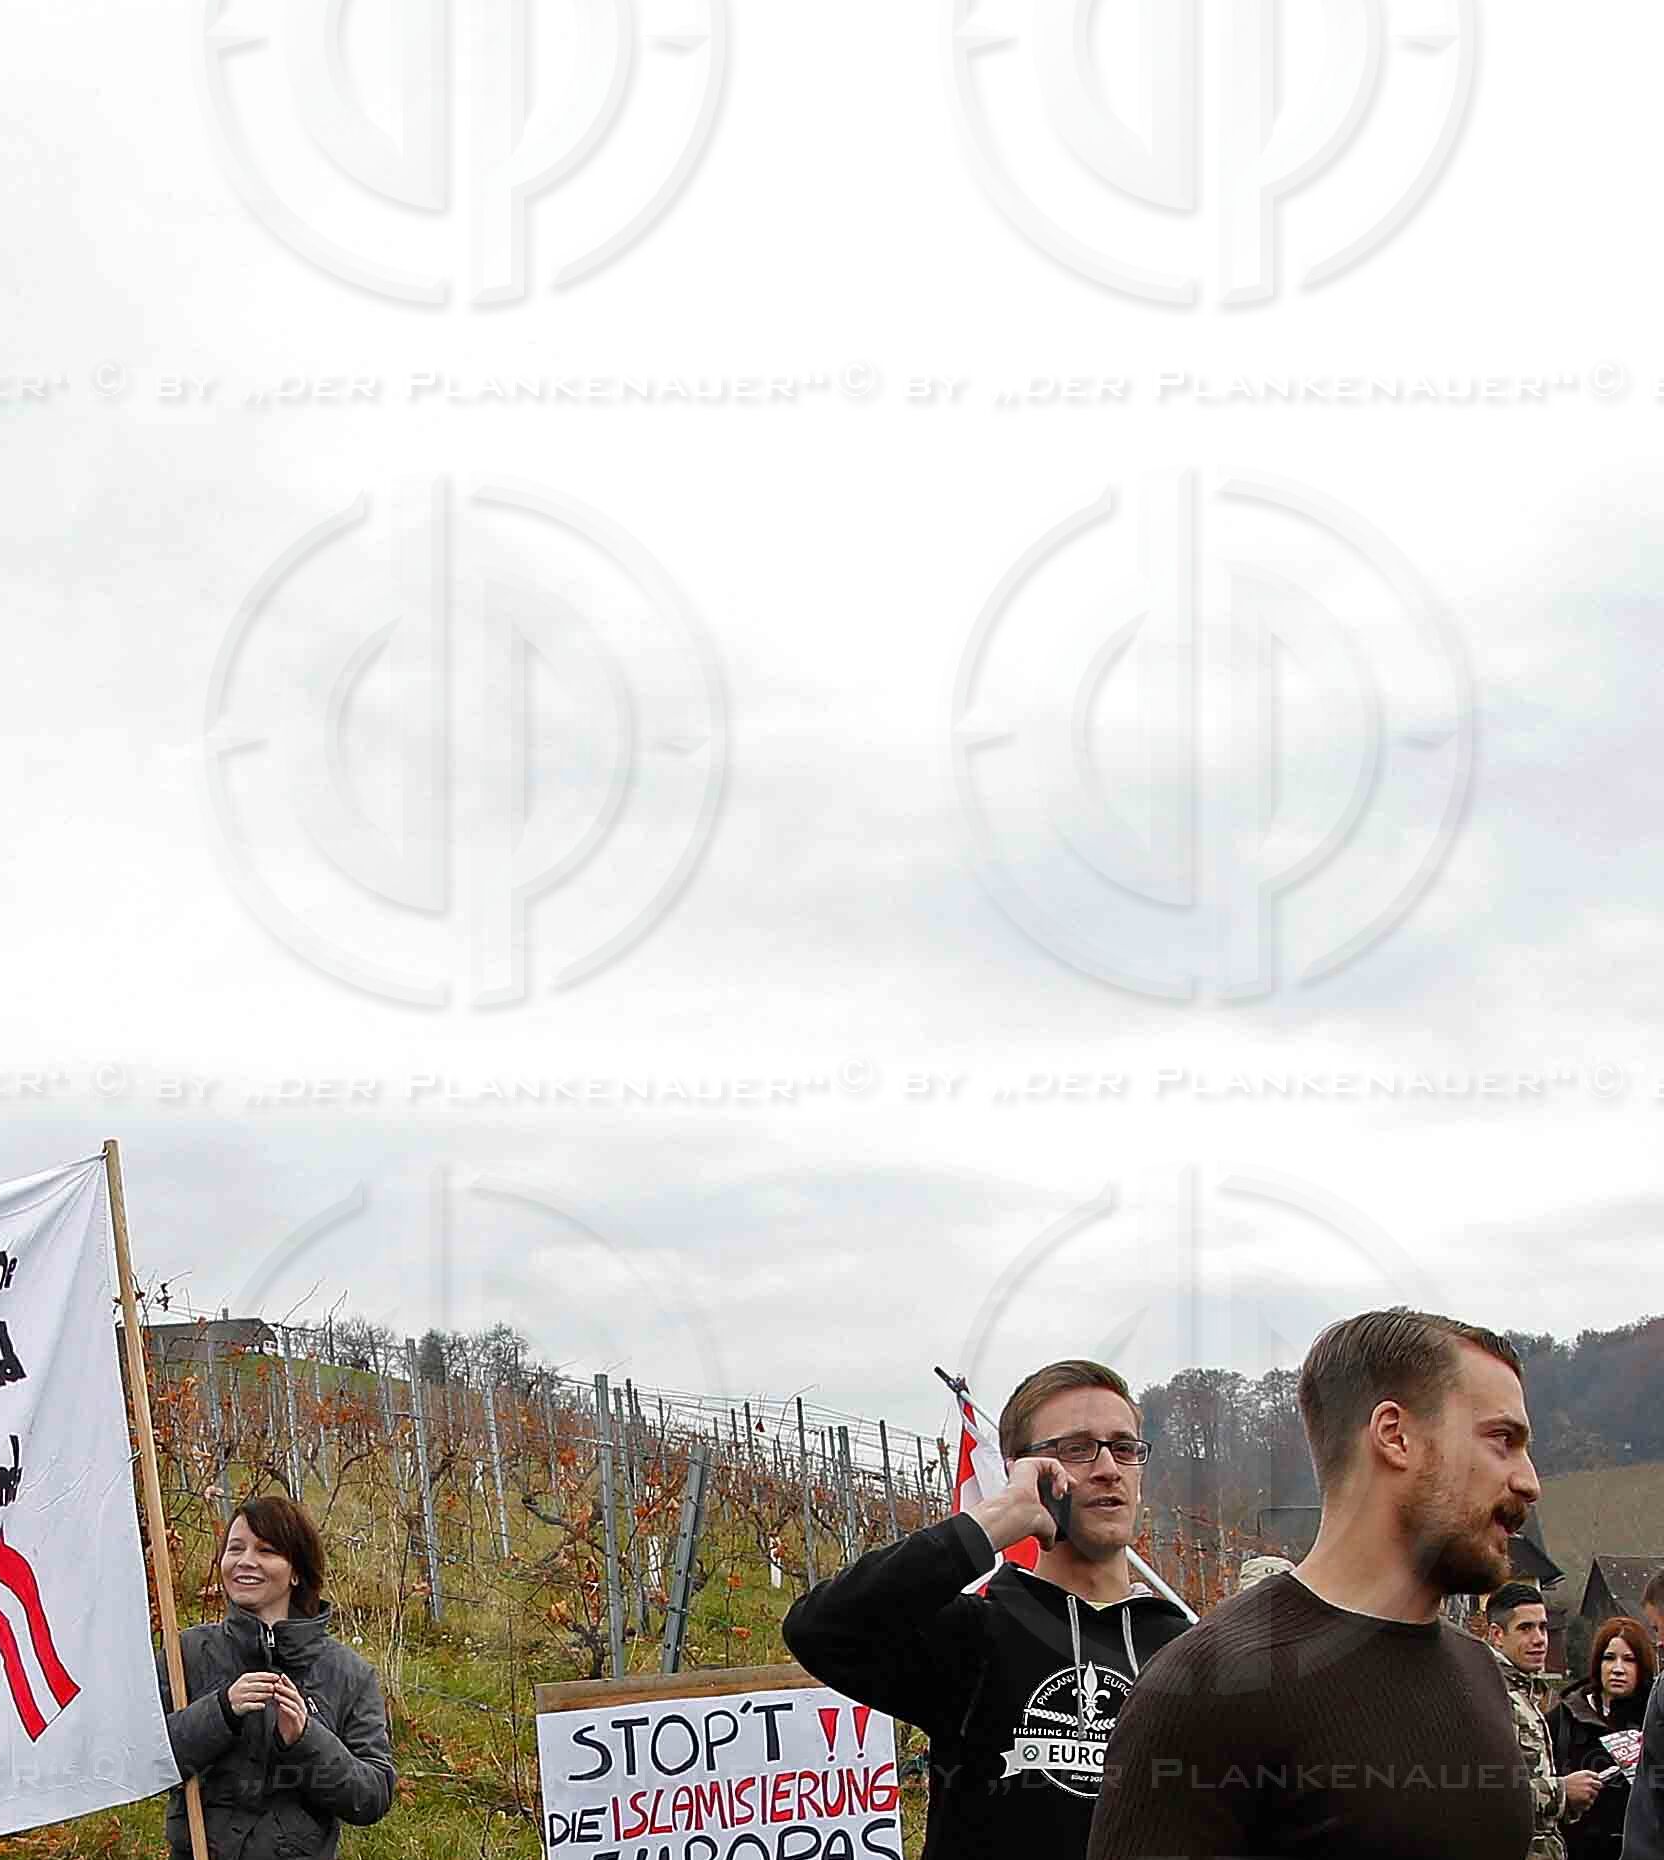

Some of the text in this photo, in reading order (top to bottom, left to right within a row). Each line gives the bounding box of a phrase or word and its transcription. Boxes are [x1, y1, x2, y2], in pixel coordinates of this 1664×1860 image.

[1089, 1732, 1107, 1741] THE
[548, 1806, 608, 1848] DIE
[611, 1761, 902, 1842] ISLAMISIERUNG
